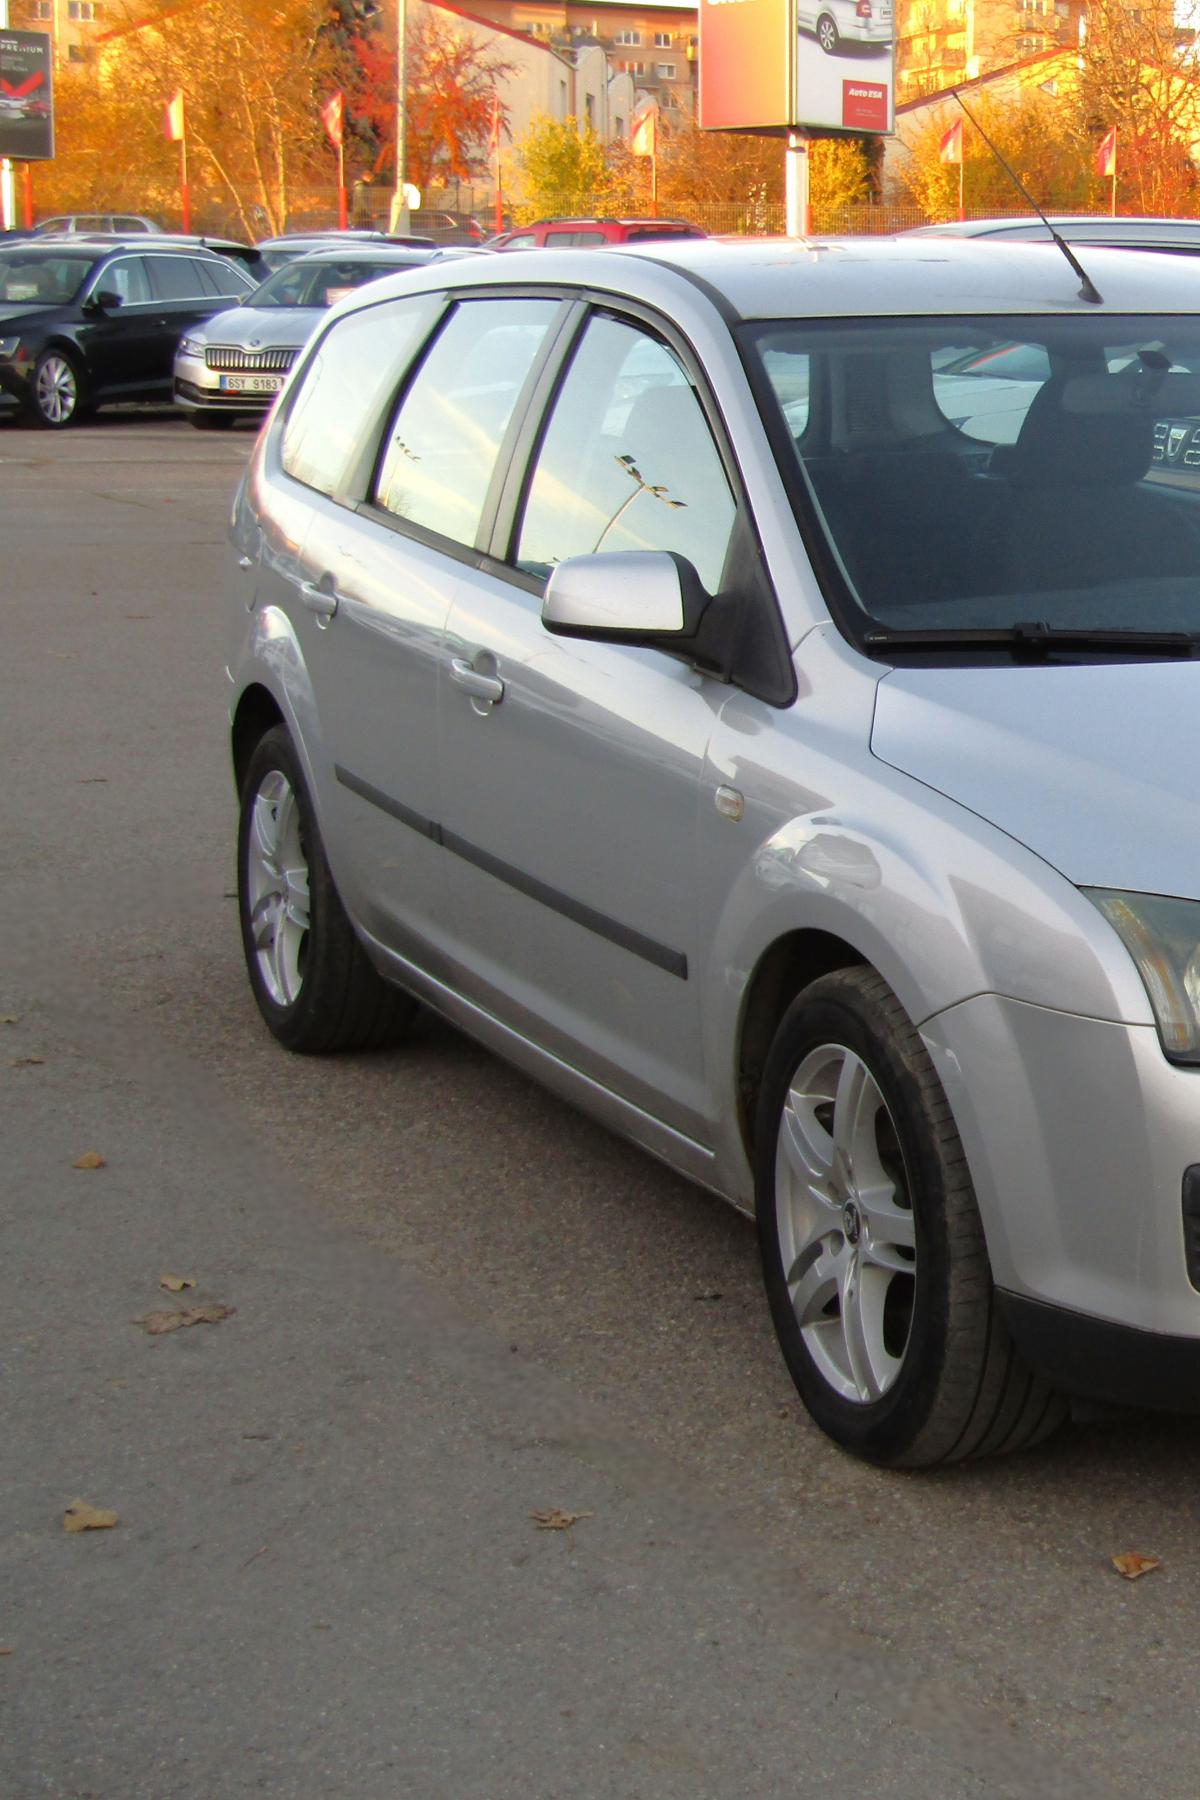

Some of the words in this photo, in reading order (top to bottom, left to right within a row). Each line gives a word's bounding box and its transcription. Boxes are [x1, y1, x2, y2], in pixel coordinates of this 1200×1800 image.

[848, 87, 868, 97] Auto
[868, 90, 883, 99] ESA
[228, 378, 246, 389] 6SY
[252, 378, 278, 390] 9183
